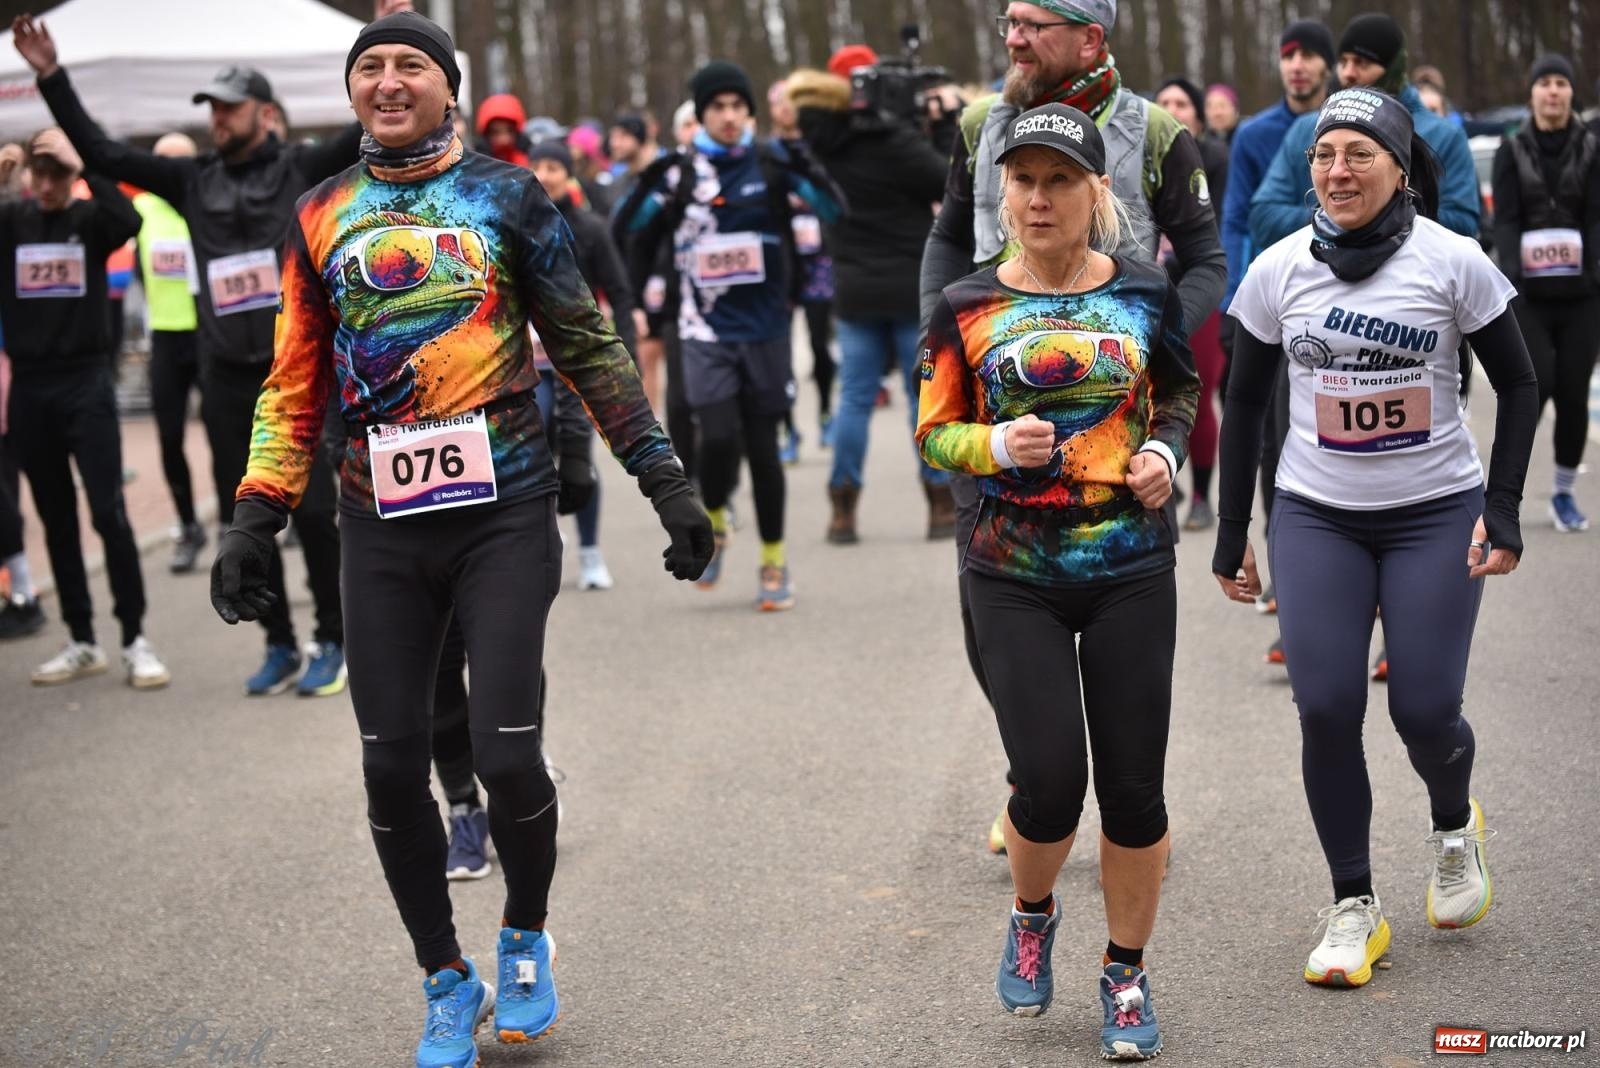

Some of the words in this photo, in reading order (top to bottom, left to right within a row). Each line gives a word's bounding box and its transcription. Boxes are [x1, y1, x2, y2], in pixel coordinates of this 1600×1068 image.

[1014, 122, 1084, 145] CHALLENGE
[1015, 113, 1084, 136] FORMOZA
[1323, 306, 1439, 353] BIEGOWO
[1322, 375, 1348, 385] BIEG
[1351, 373, 1422, 386] Twardziela
[400, 415, 474, 434] Twardziela
[1339, 399, 1406, 432] 105
[392, 444, 465, 486] 076
